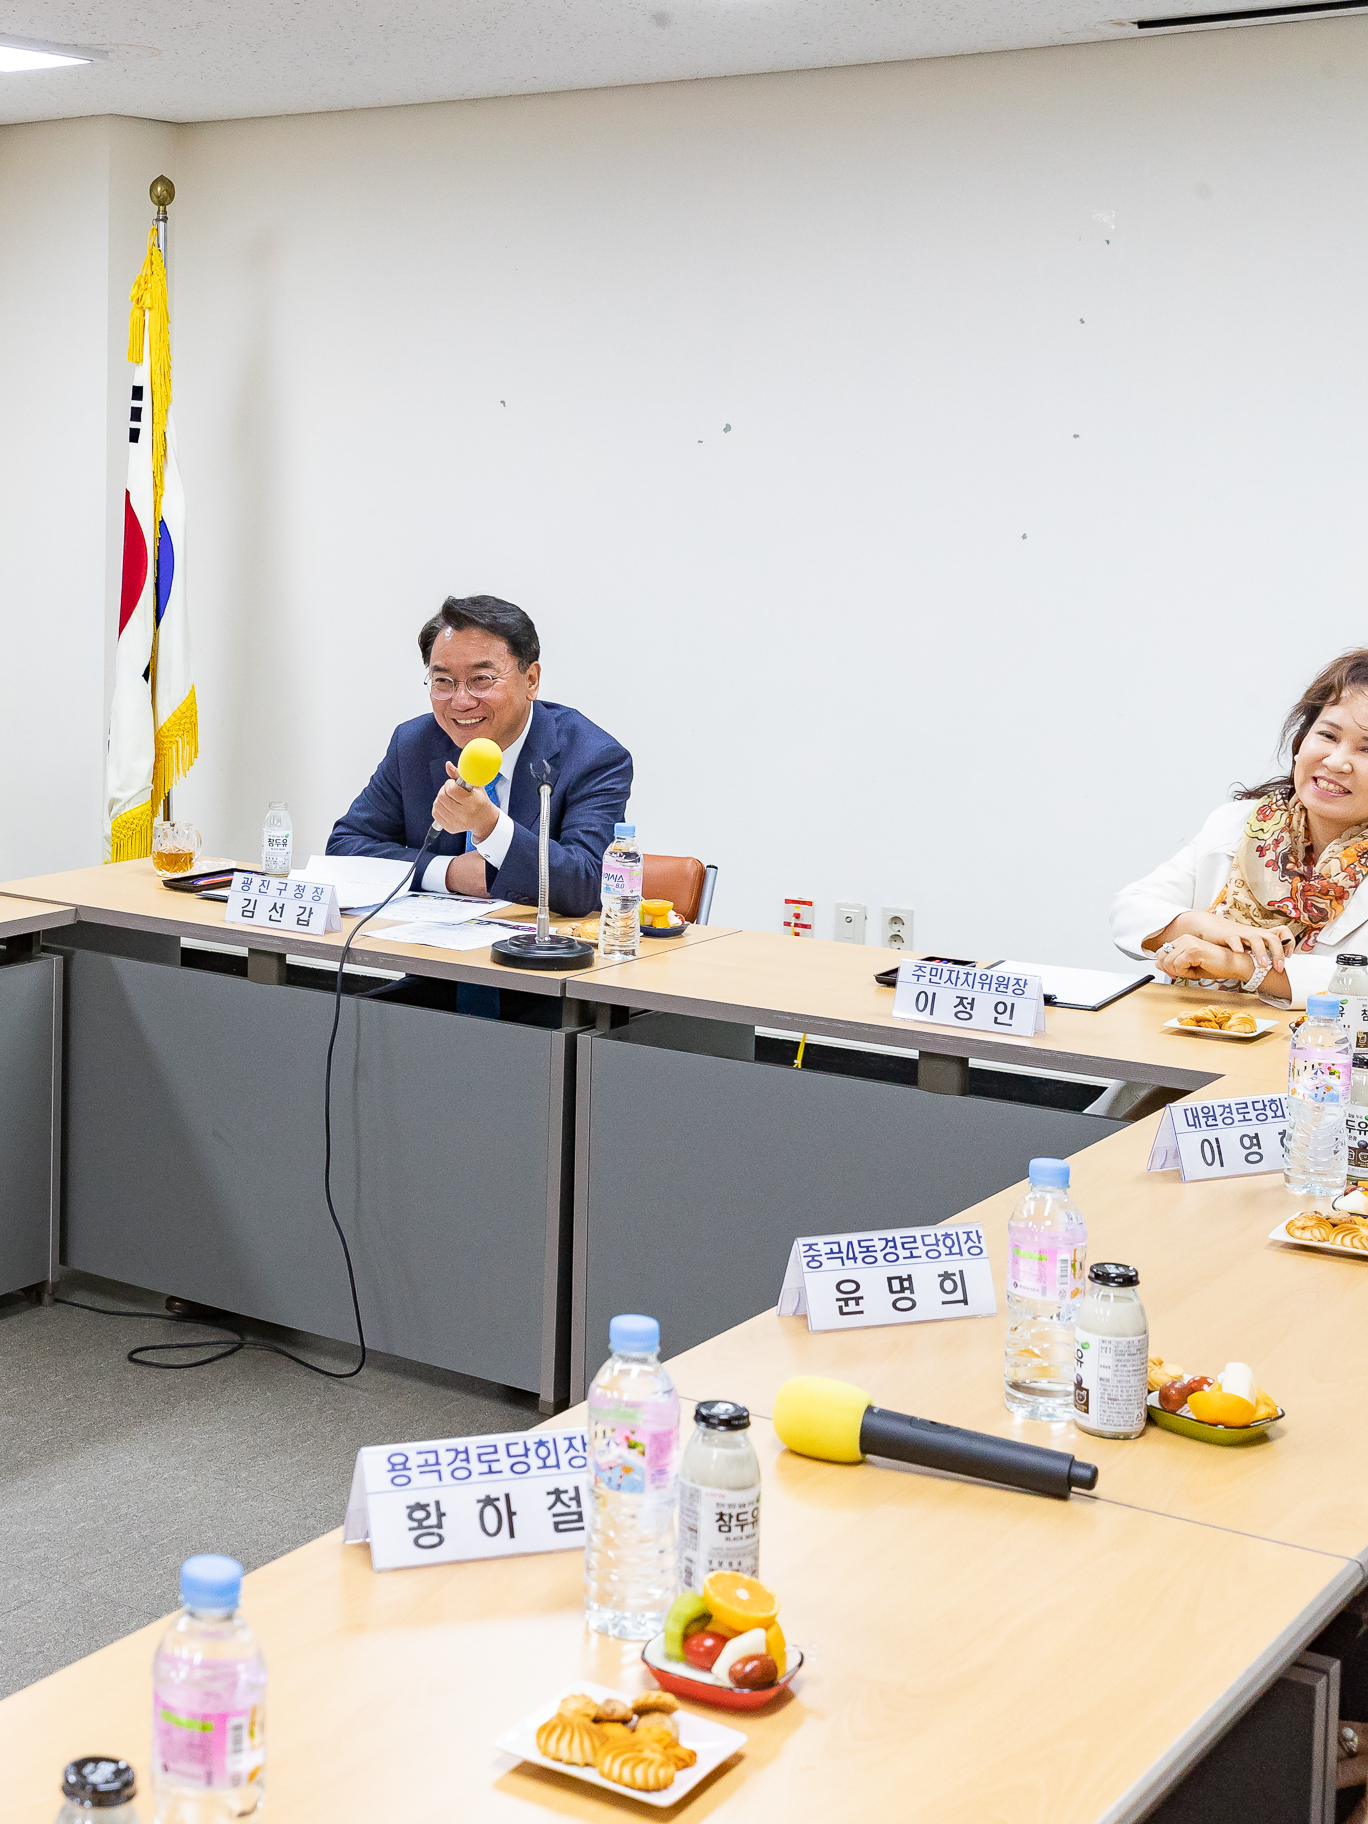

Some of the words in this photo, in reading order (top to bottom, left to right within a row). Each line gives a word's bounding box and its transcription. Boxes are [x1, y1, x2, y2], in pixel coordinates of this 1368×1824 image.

[911, 964, 1028, 996] 주민자치위원장
[1183, 1097, 1292, 1129] 대원경로당회
[1345, 1119, 1368, 1136] 두유
[802, 1229, 984, 1270] 중곡4동경로당회장
[387, 1434, 588, 1487] 용곡경로당회장
[715, 1509, 759, 1534] 참두유
